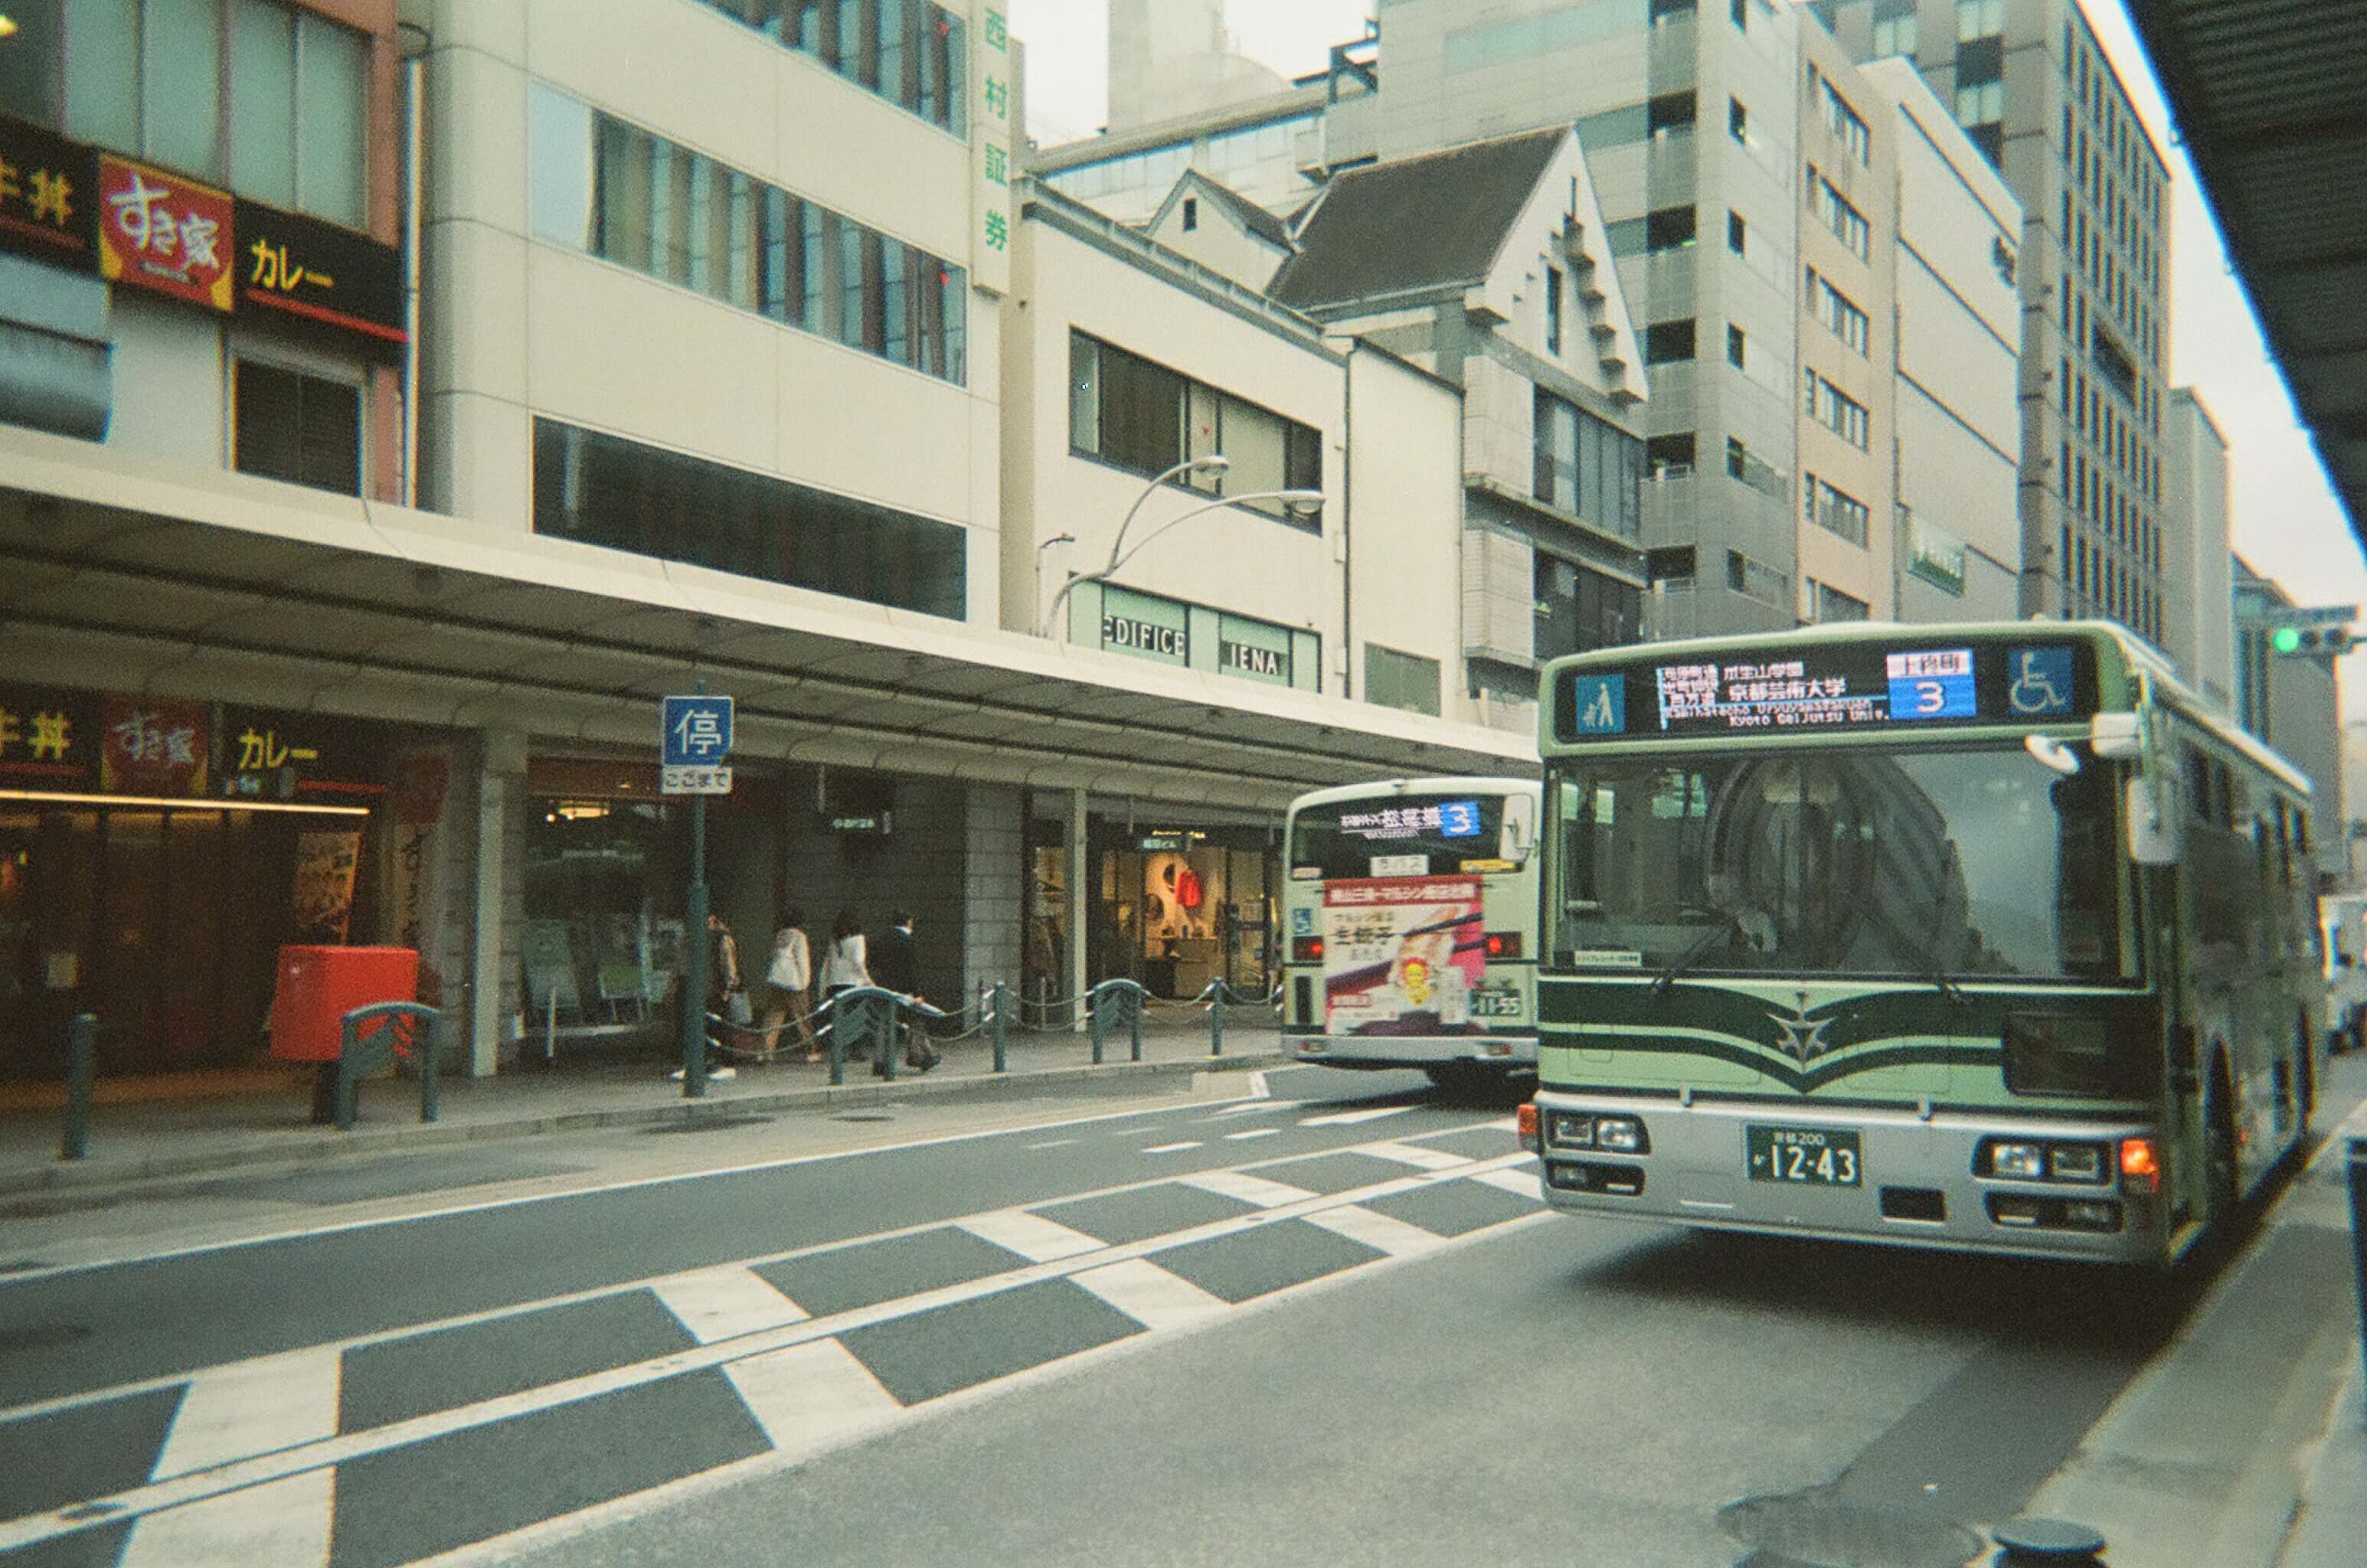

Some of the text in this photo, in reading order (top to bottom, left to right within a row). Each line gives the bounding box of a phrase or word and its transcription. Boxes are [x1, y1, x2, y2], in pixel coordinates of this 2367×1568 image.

[984, 7, 1008, 253] 西村証券
[109, 169, 220, 270] すき家
[251, 237, 335, 291] カレー
[1231, 643, 1279, 676] IENA
[1723, 661, 1804, 681] 瓜生山学園
[1728, 675, 1847, 702] 京都芸術大学
[1915, 681, 1945, 713] 3
[114, 711, 195, 763] すき家
[675, 709, 721, 755] 停
[1729, 714, 1771, 727] Kyoto
[239, 727, 319, 770] カレー
[665, 772, 728, 789] ここまで
[1449, 805, 1472, 833] 3
